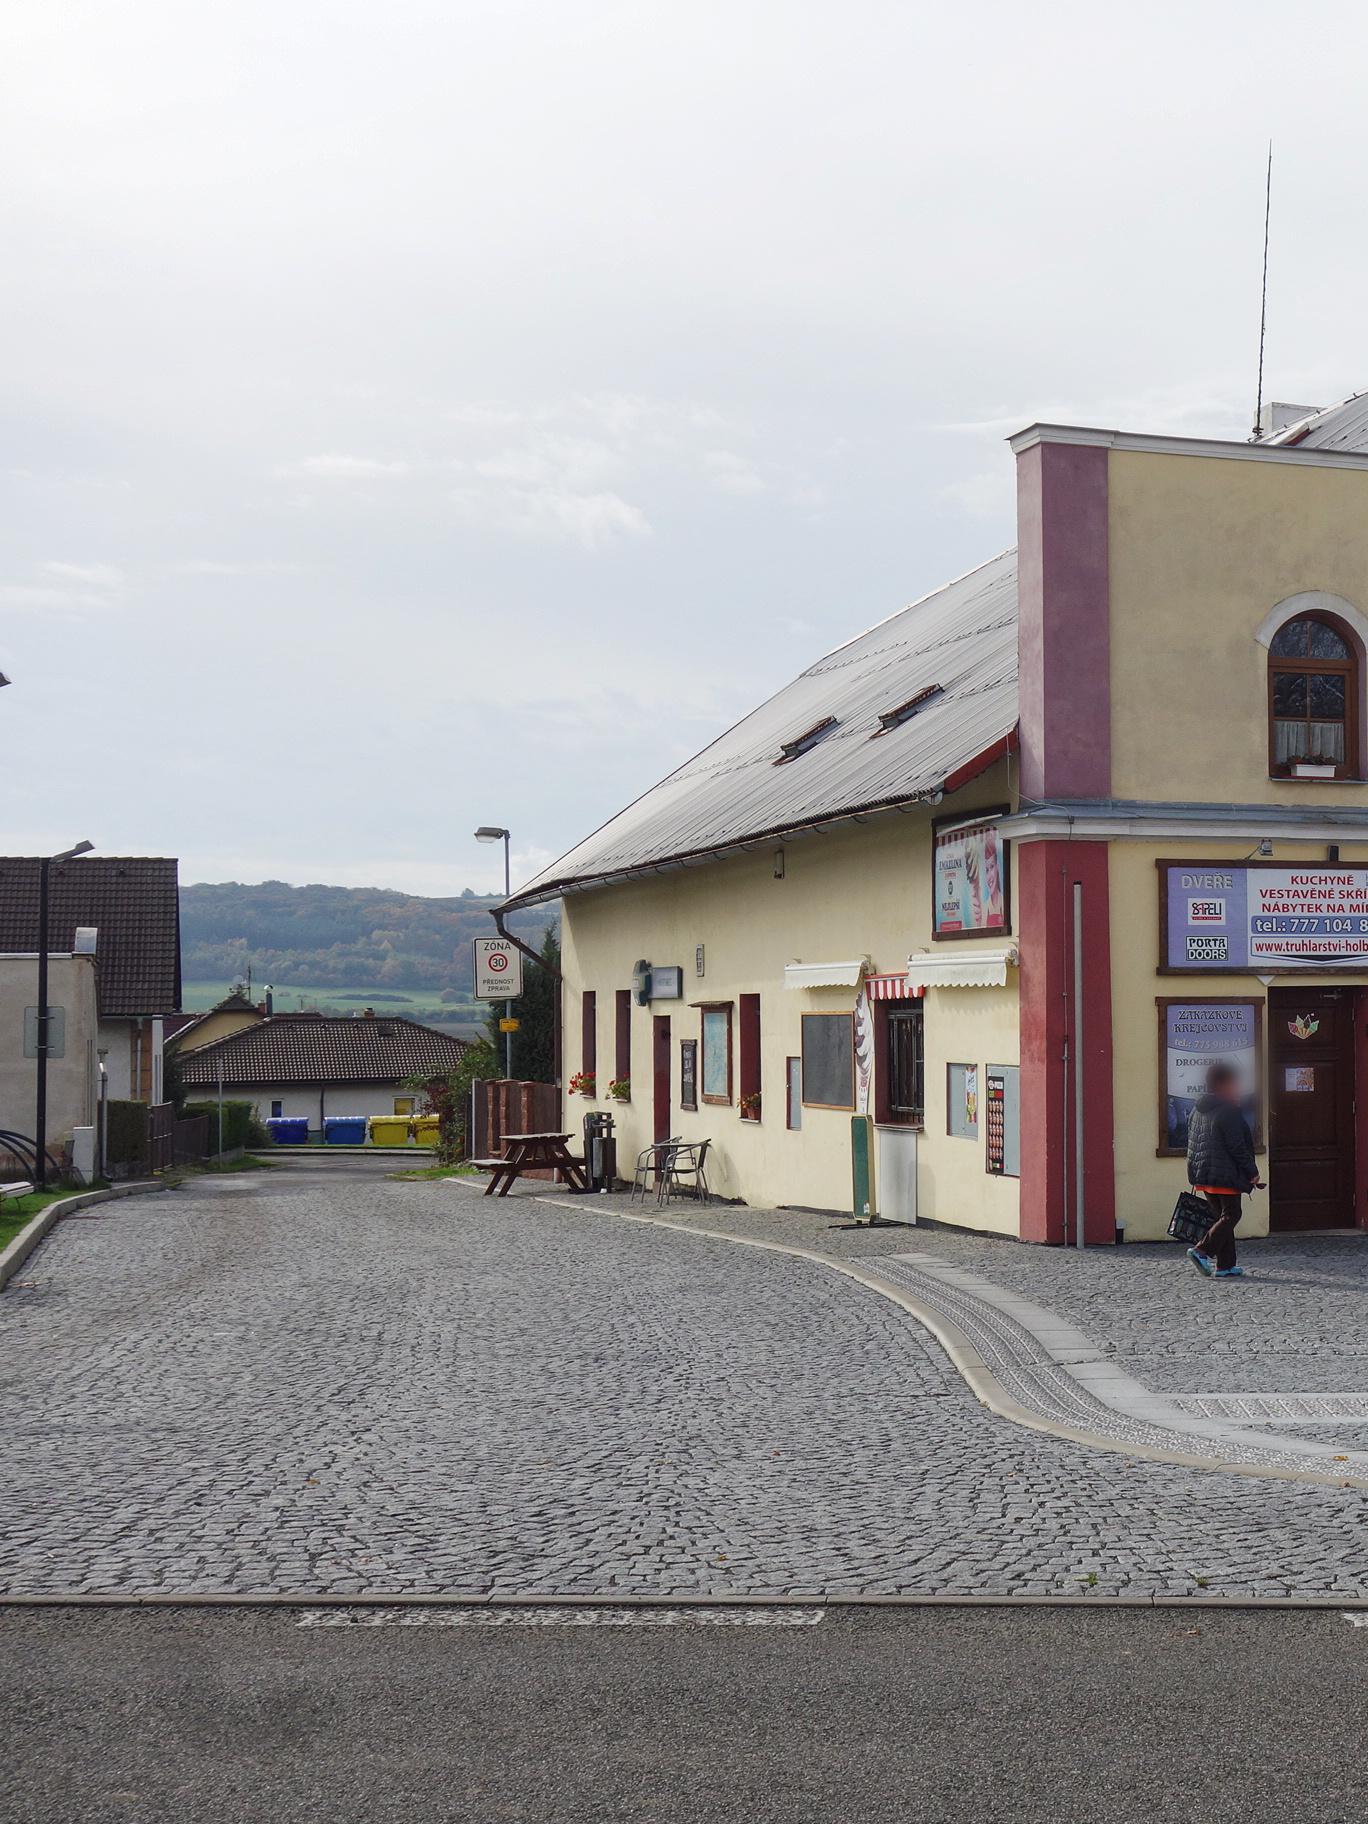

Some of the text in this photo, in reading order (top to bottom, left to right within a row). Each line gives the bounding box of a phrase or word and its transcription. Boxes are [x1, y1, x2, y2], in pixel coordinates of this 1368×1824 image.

[1181, 872, 1233, 889] DVEŘE
[1291, 874, 1354, 886] KUCHYNĚ
[1259, 888, 1335, 899] VESTAVĚNÉ
[1191, 902, 1222, 915] SAPELI
[1262, 901, 1323, 913] NÁBYTEK
[1327, 903, 1346, 913] NA
[1255, 918, 1286, 932] tel.:
[1289, 918, 1319, 932] 777
[1323, 918, 1352, 932] 104
[484, 941, 511, 951] ZÓNA
[1188, 938, 1226, 948] PORTA
[1188, 949, 1226, 959] DOORS
[492, 957, 504, 968] 30
[1175, 1058, 1219, 1067] DROGERI
